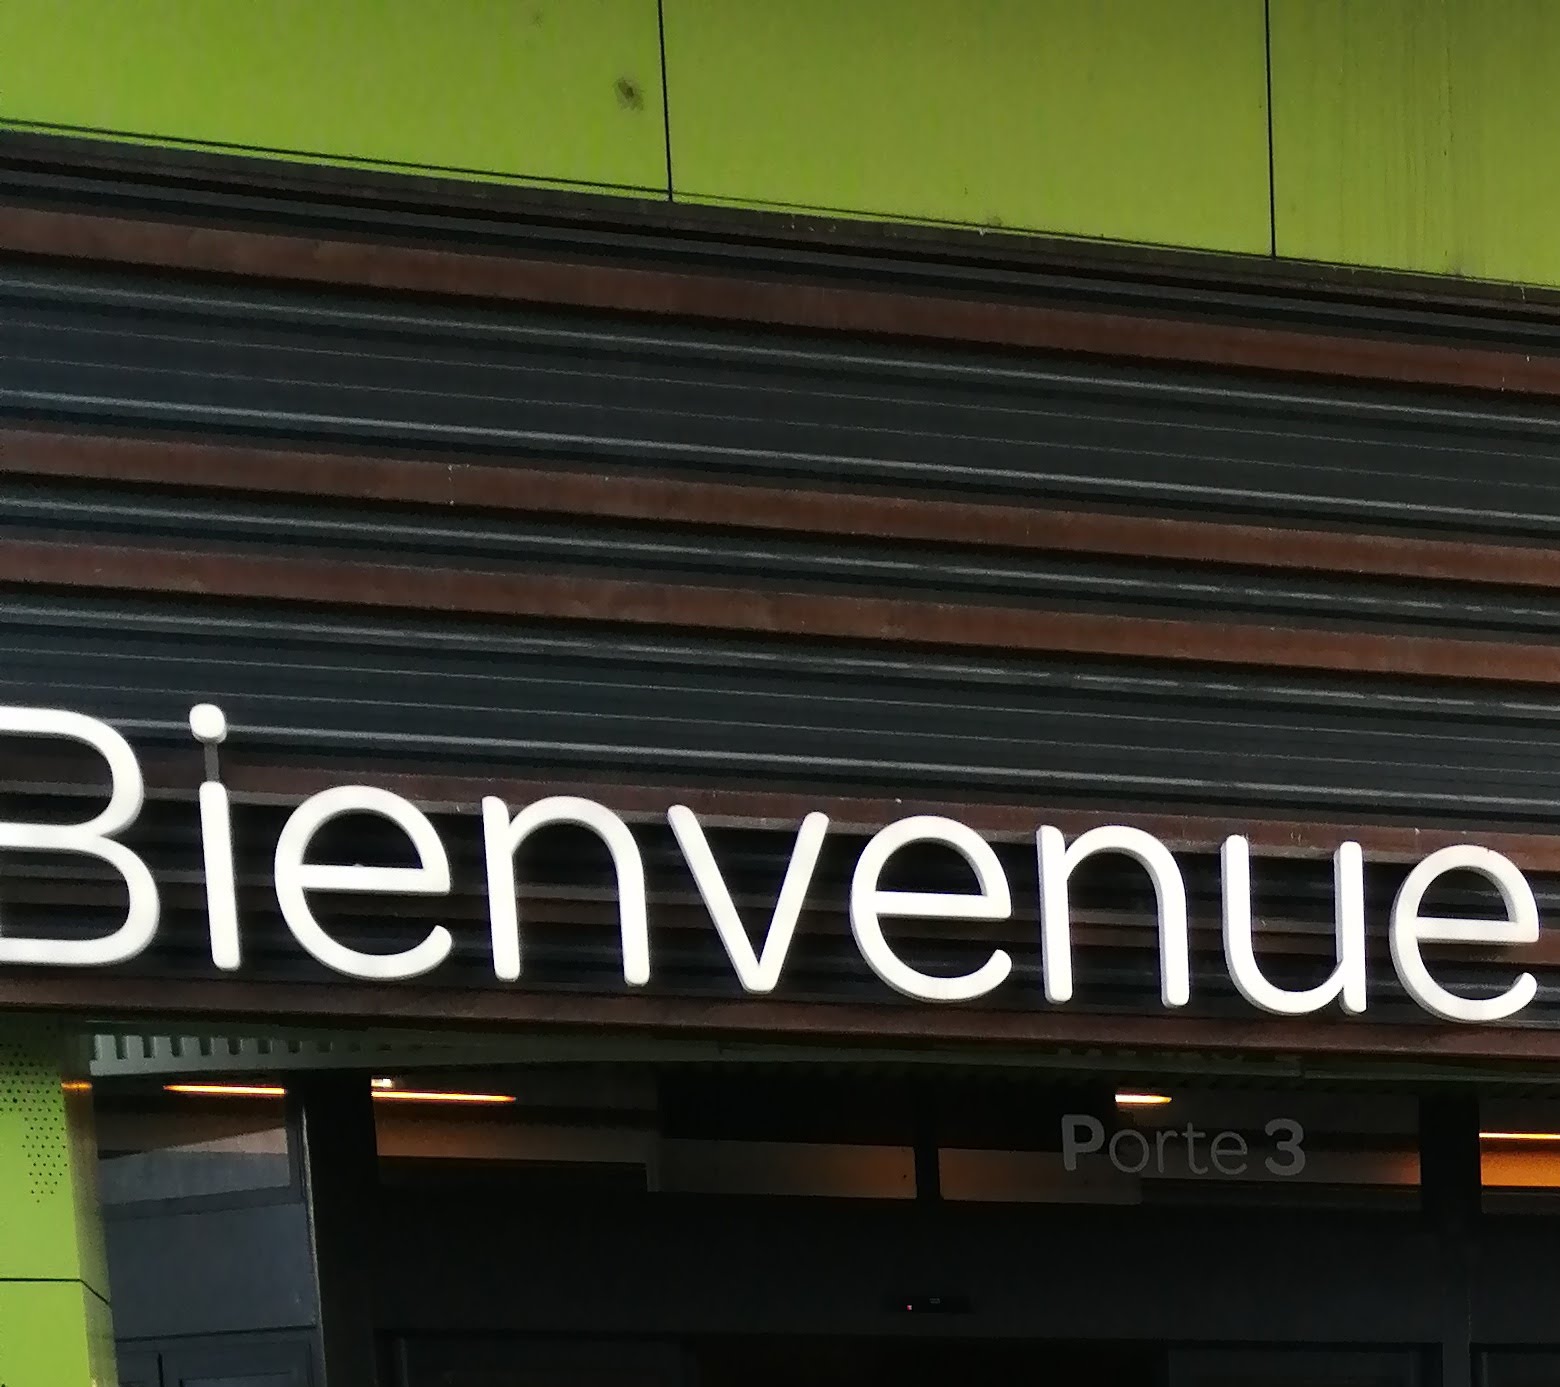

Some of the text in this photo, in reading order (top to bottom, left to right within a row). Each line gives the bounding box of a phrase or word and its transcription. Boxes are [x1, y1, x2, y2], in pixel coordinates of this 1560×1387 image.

[0, 703, 1541, 1021] Bienvenue
[1061, 1114, 1306, 1176] Porte 3
